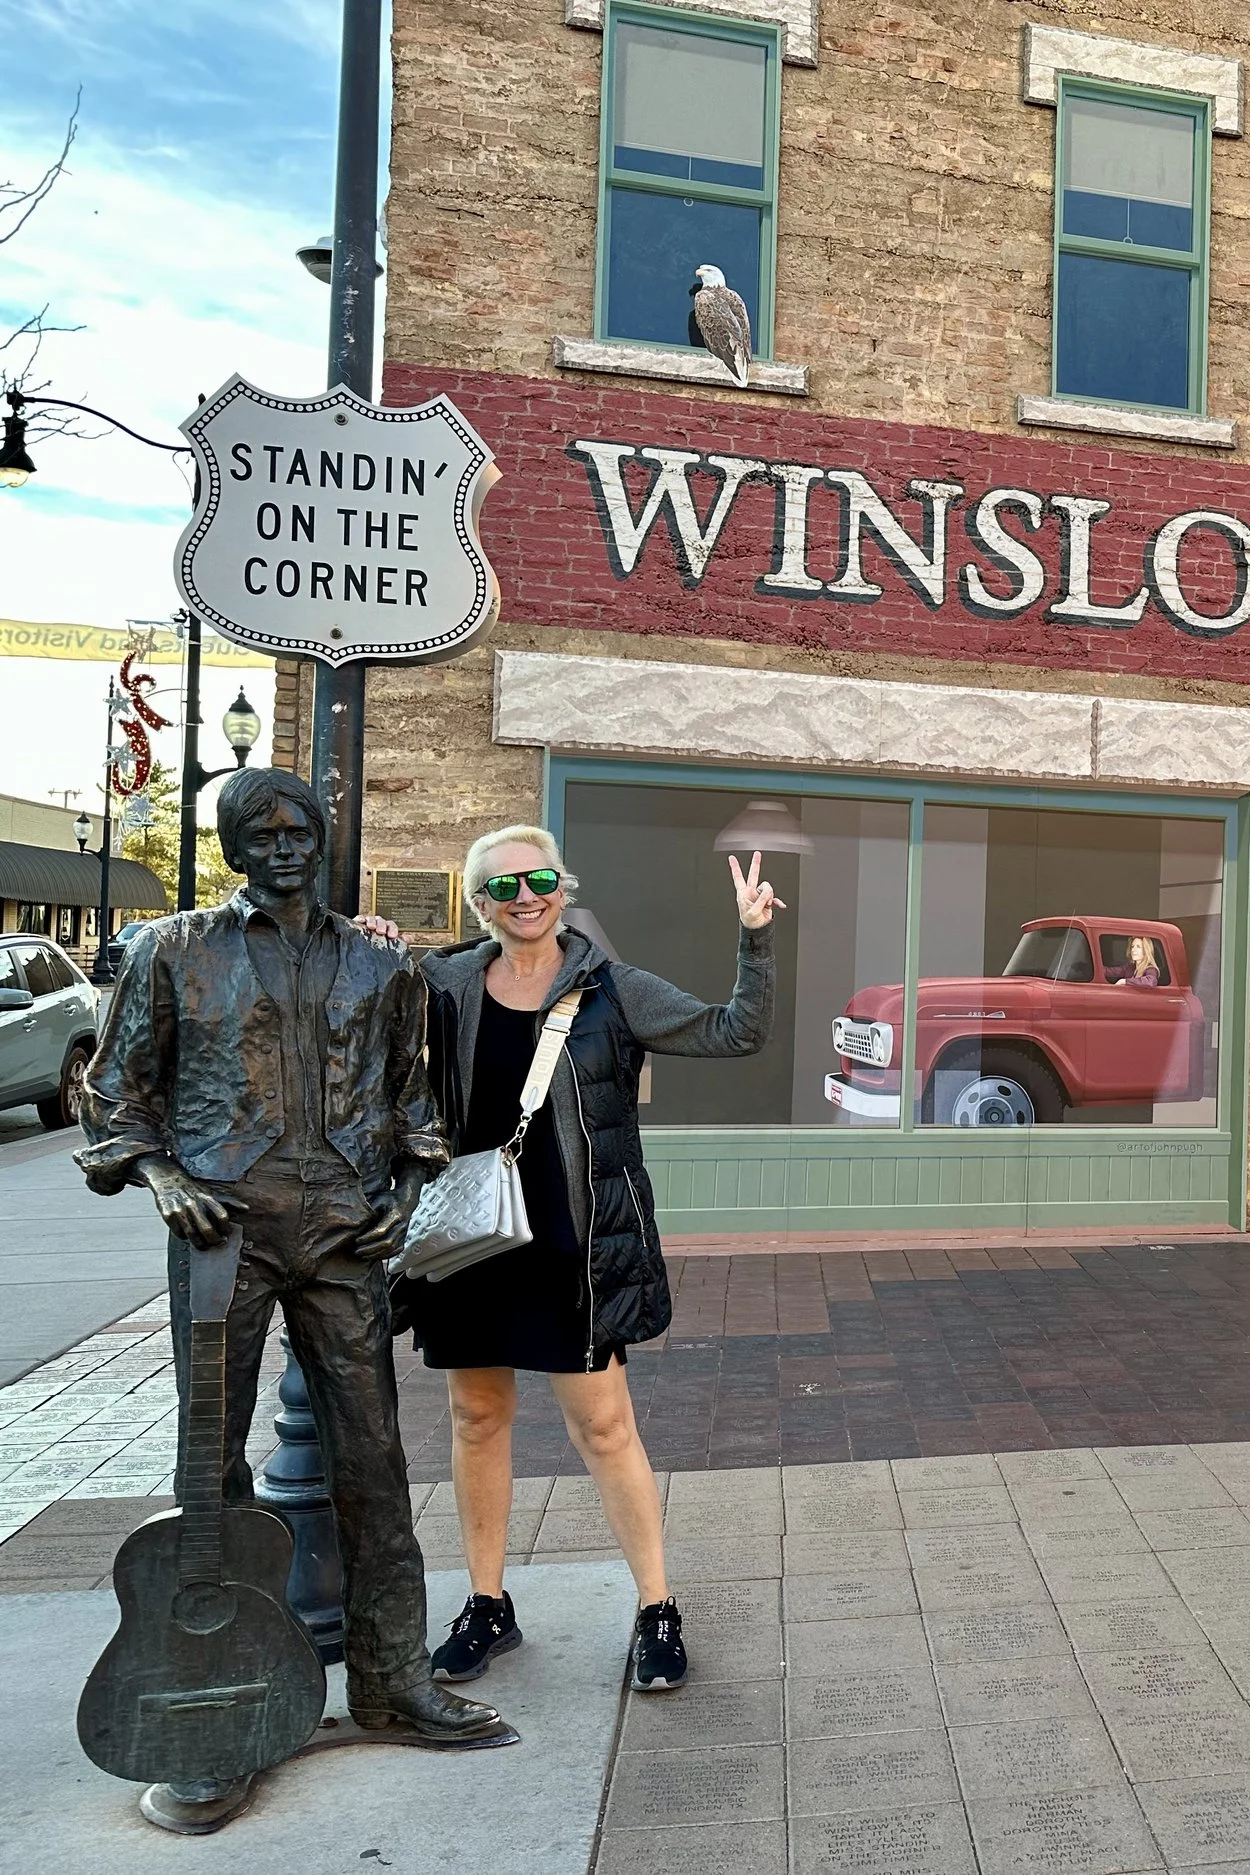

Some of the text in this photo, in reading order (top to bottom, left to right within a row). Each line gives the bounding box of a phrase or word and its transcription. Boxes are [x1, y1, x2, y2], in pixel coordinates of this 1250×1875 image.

[230, 442, 448, 496] STANDIN'
[256, 502, 419, 552] ON THE
[244, 557, 429, 607] CORNER
[1117, 1143, 1203, 1153] @artofjohnpugh
[1025, 1815, 1088, 1825] DOROTHY
[1030, 1803, 1074, 1811] FAMILY
